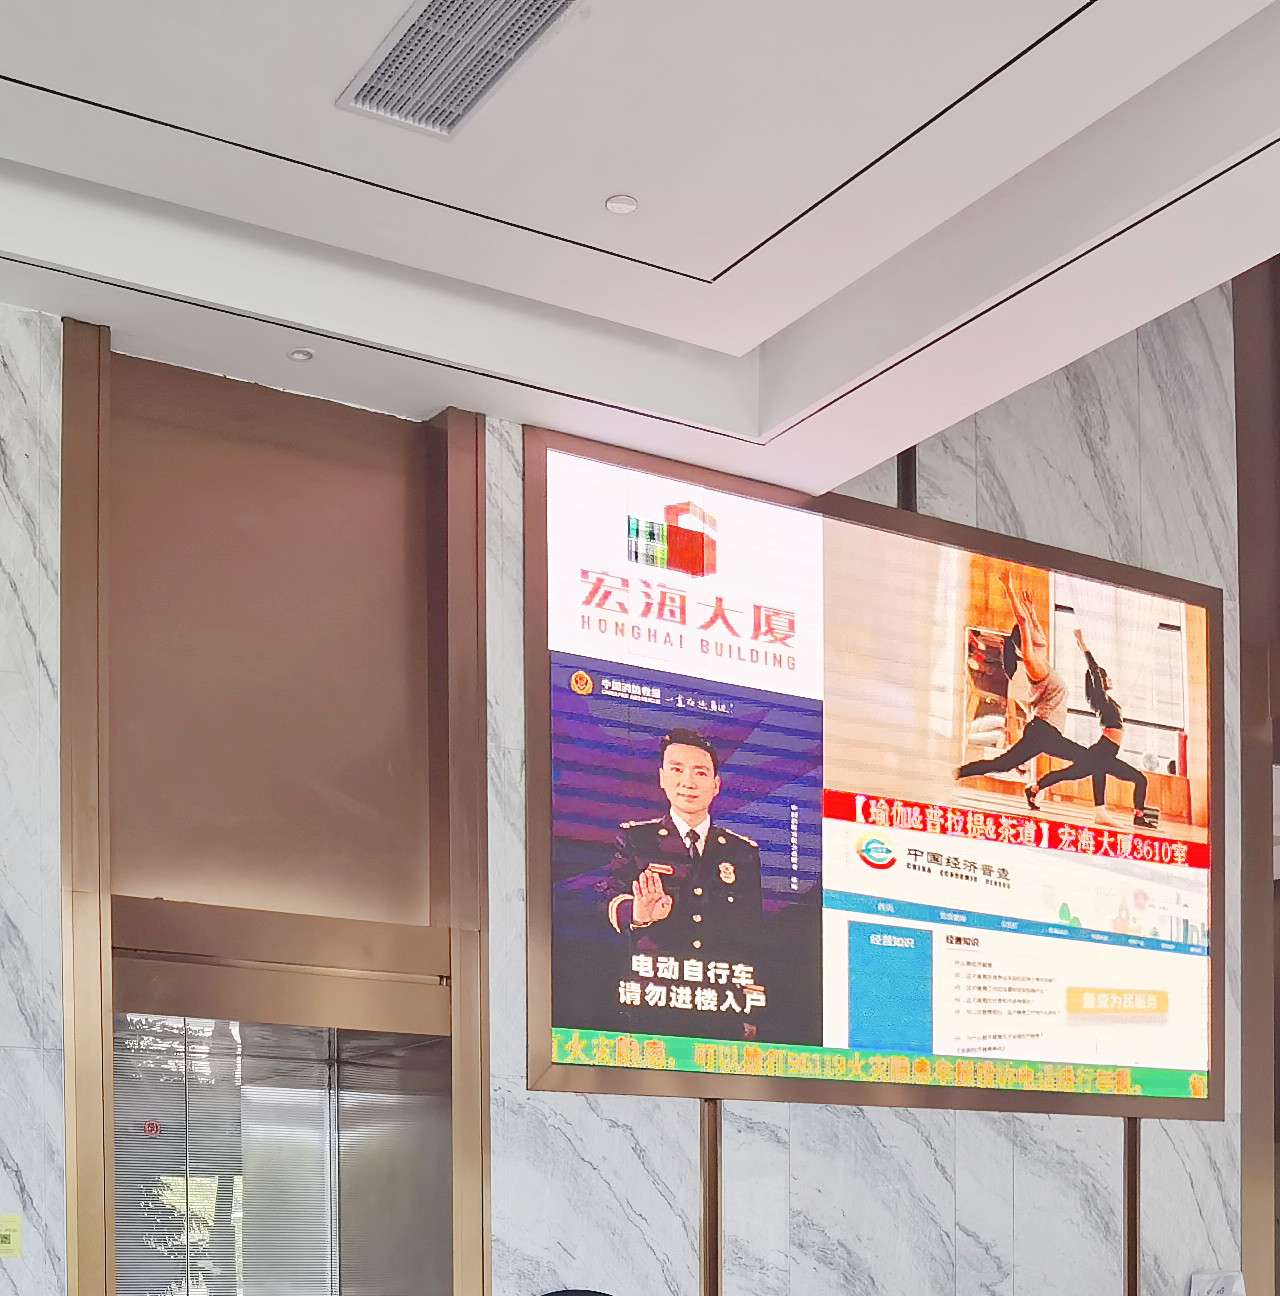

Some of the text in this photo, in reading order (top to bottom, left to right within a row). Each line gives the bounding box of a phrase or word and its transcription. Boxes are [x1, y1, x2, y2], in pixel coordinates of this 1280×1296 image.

[579, 568, 797, 648] 宏海大厦
[580, 614, 797, 672] HONGHAI BUILDING
[906, 847, 1011, 881] 中国经济普查
[631, 953, 754, 986] 电动自行车
[618, 980, 767, 1015] 请勿进楼入户
